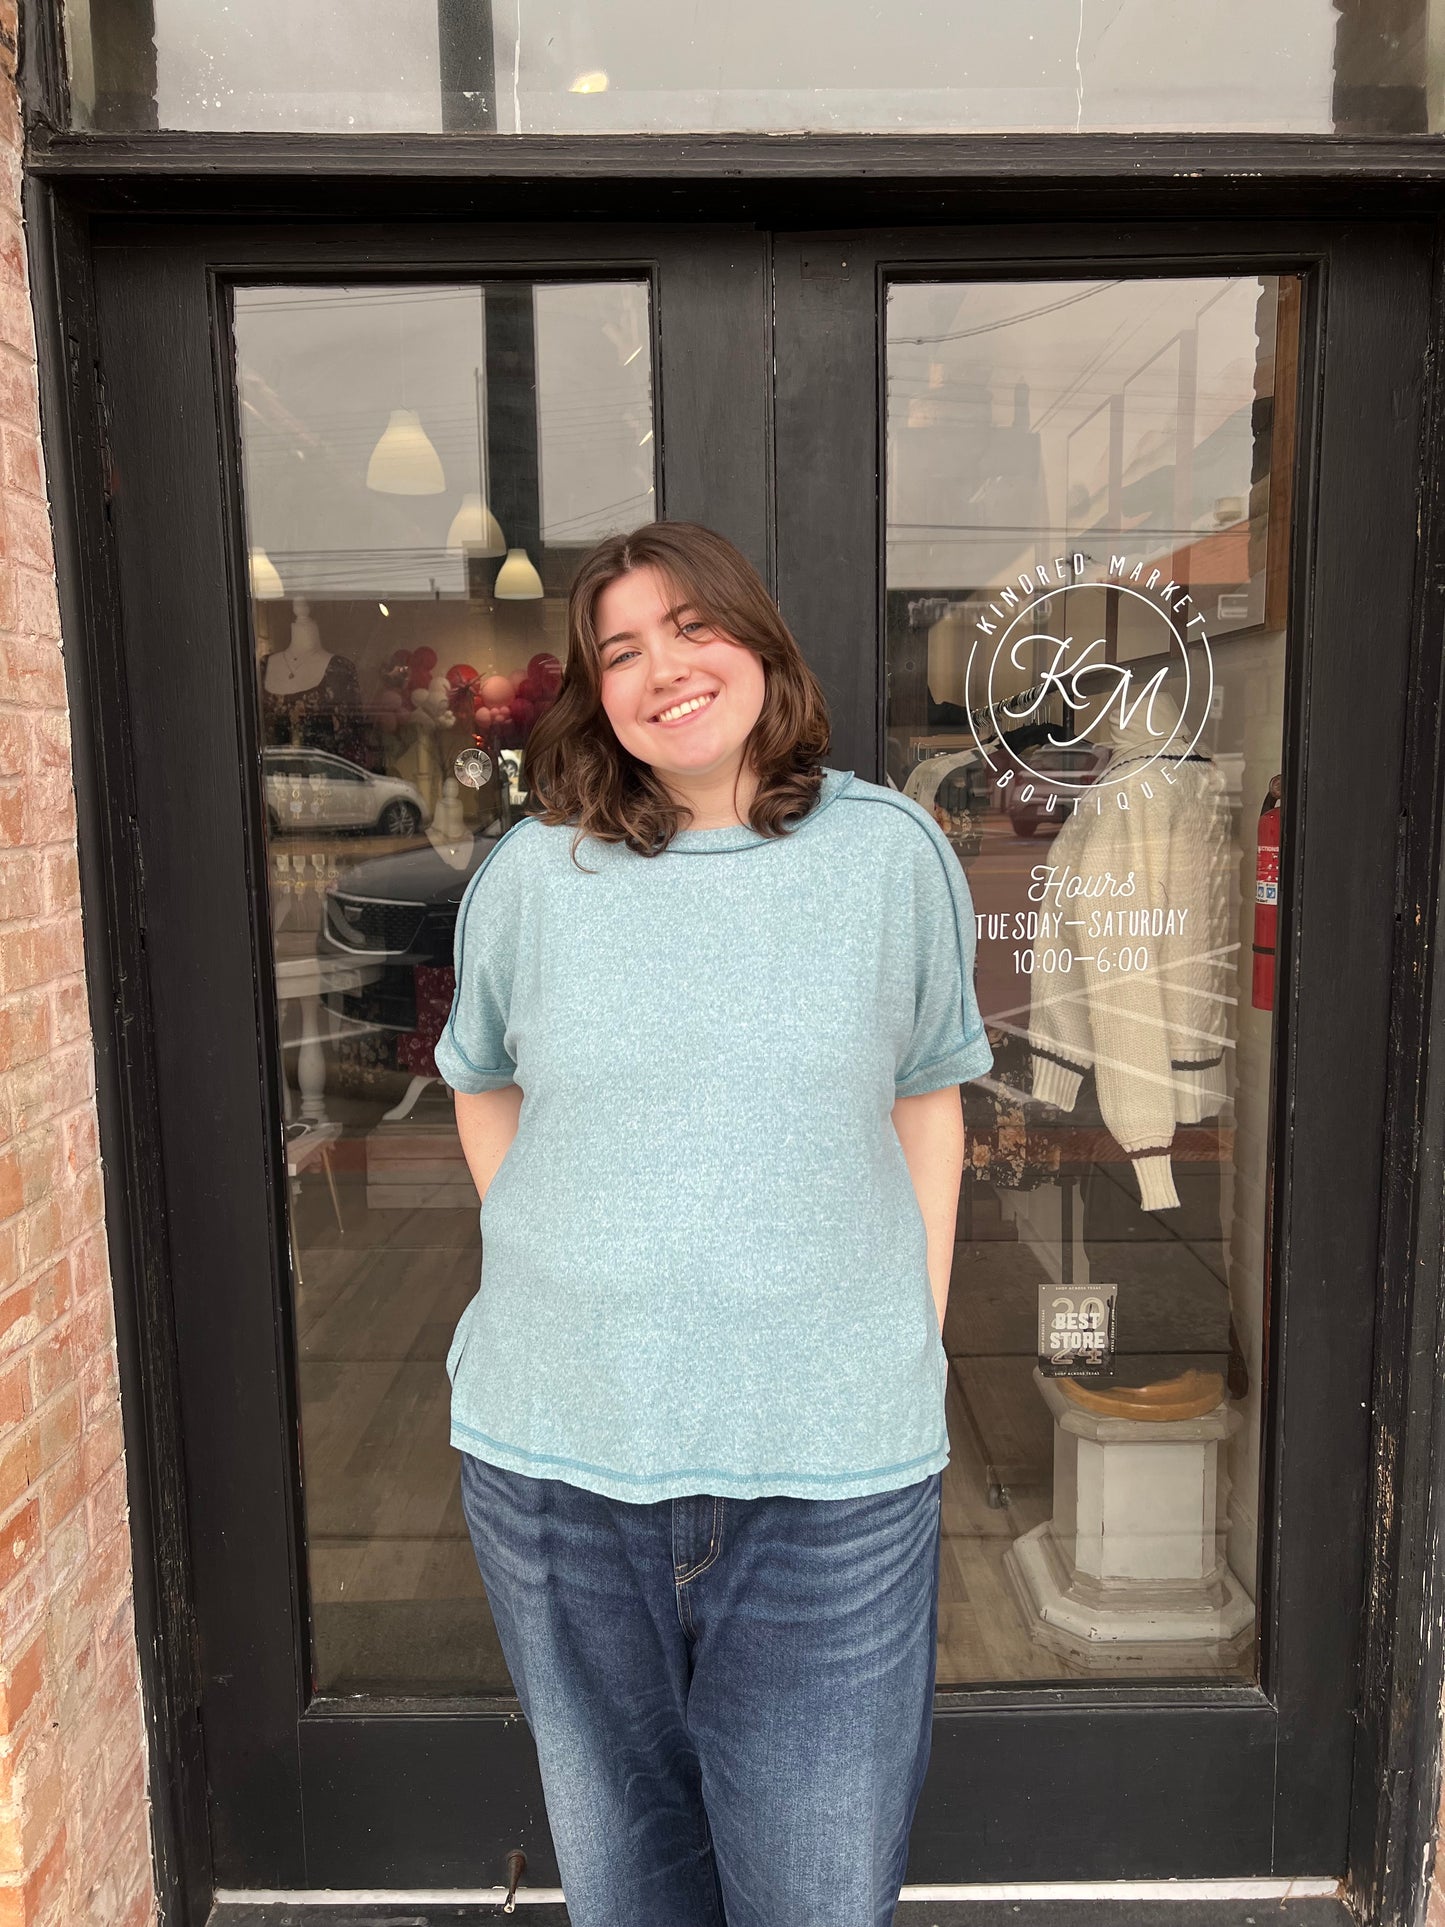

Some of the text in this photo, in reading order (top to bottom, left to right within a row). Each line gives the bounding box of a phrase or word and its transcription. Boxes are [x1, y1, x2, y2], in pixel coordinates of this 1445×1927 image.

[976, 553, 1206, 635] KINDRED MARKET
[996, 766, 1177, 815] BOUTIQUE
[1028, 865, 1136, 907] Hours
[1050, 1331, 1105, 1349] STORE
[1055, 1312, 1101, 1330] BEST
